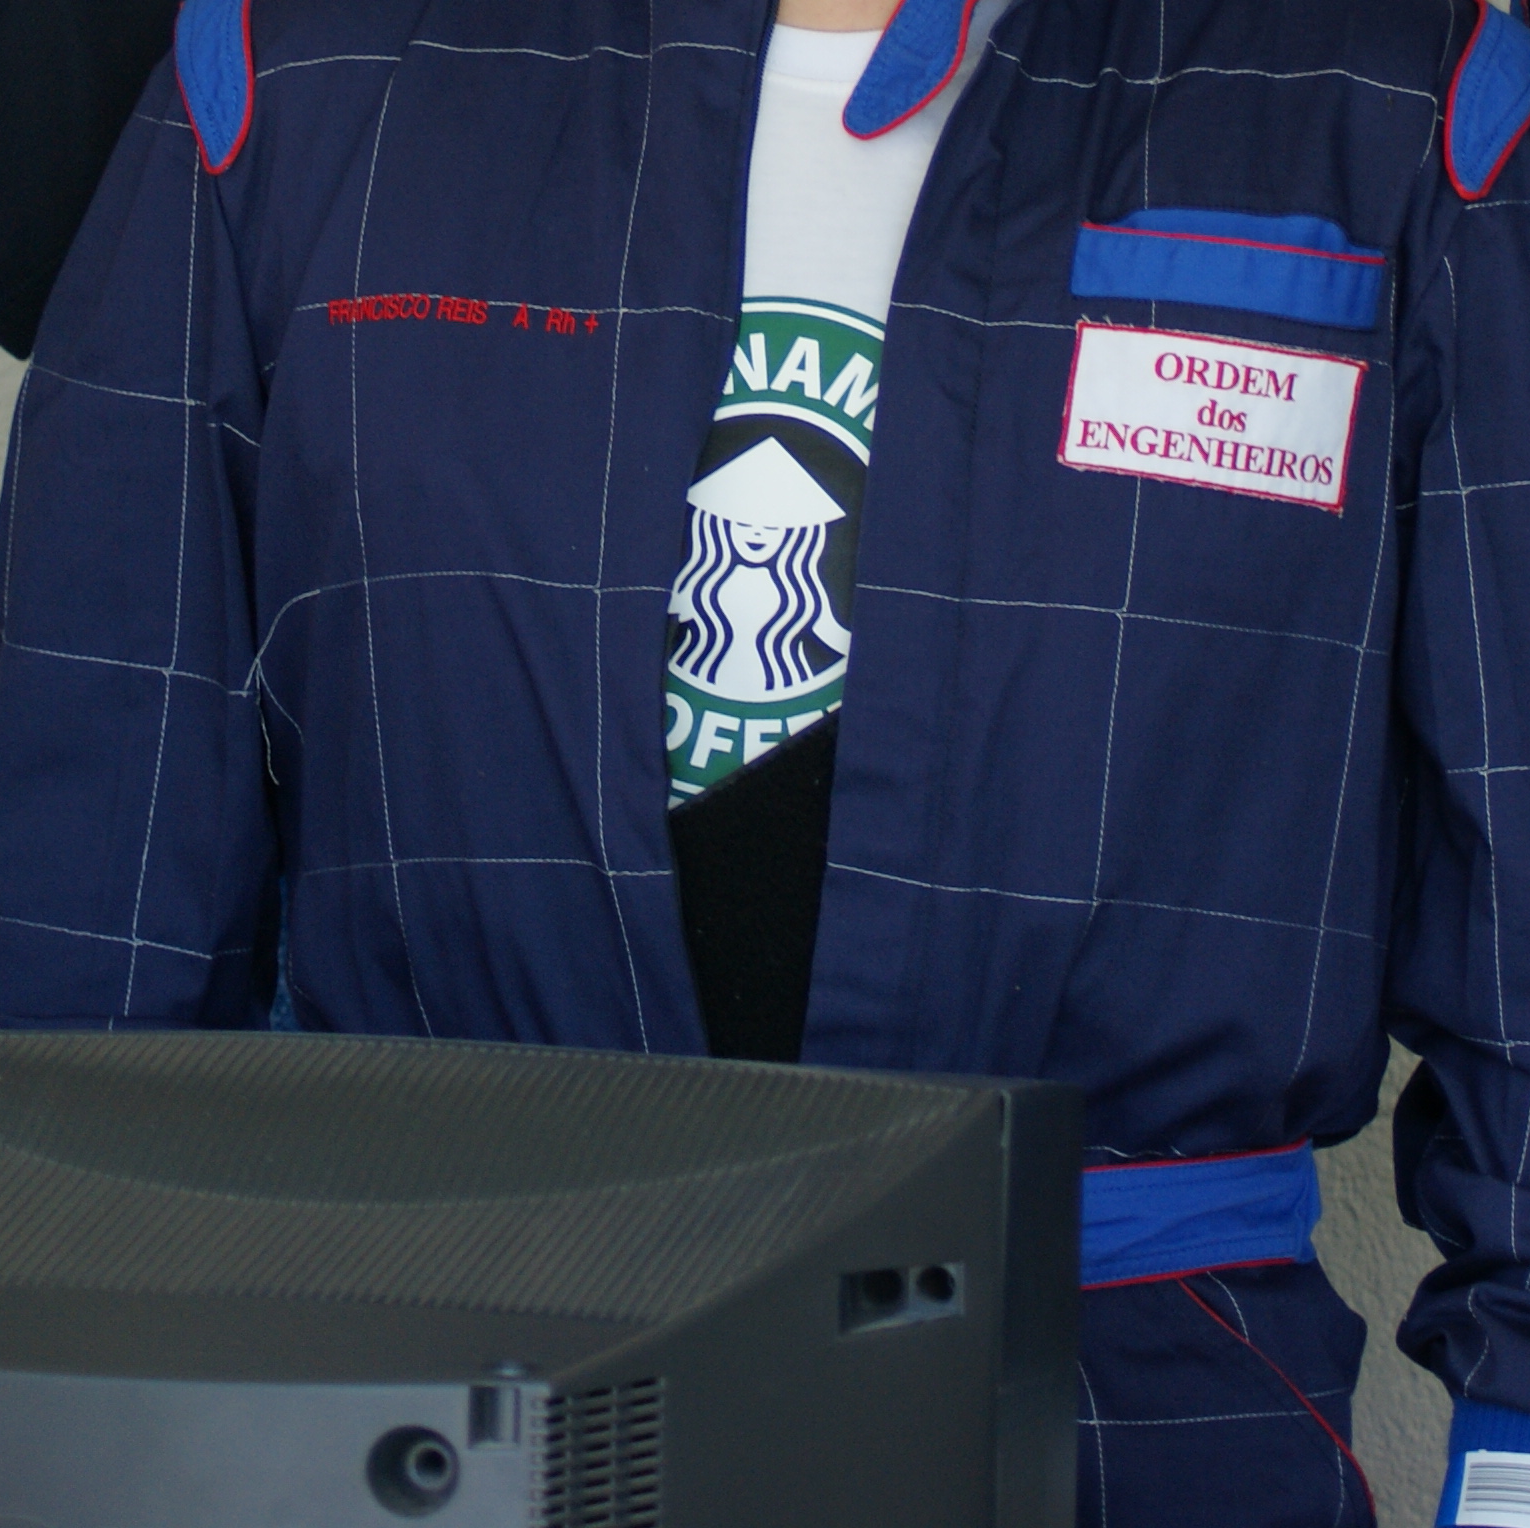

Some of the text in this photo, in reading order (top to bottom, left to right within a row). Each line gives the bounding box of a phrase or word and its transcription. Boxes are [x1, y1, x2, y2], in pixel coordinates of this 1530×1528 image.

[328, 293, 432, 325] FRANCISCO
[436, 296, 488, 324] REIS
[513, 303, 529, 329] A
[546, 308, 576, 335] Rh
[1154, 352, 1298, 402] ORDEM
[1196, 398, 1248, 433] dos
[1075, 419, 1334, 486] ENGENHEIROS
